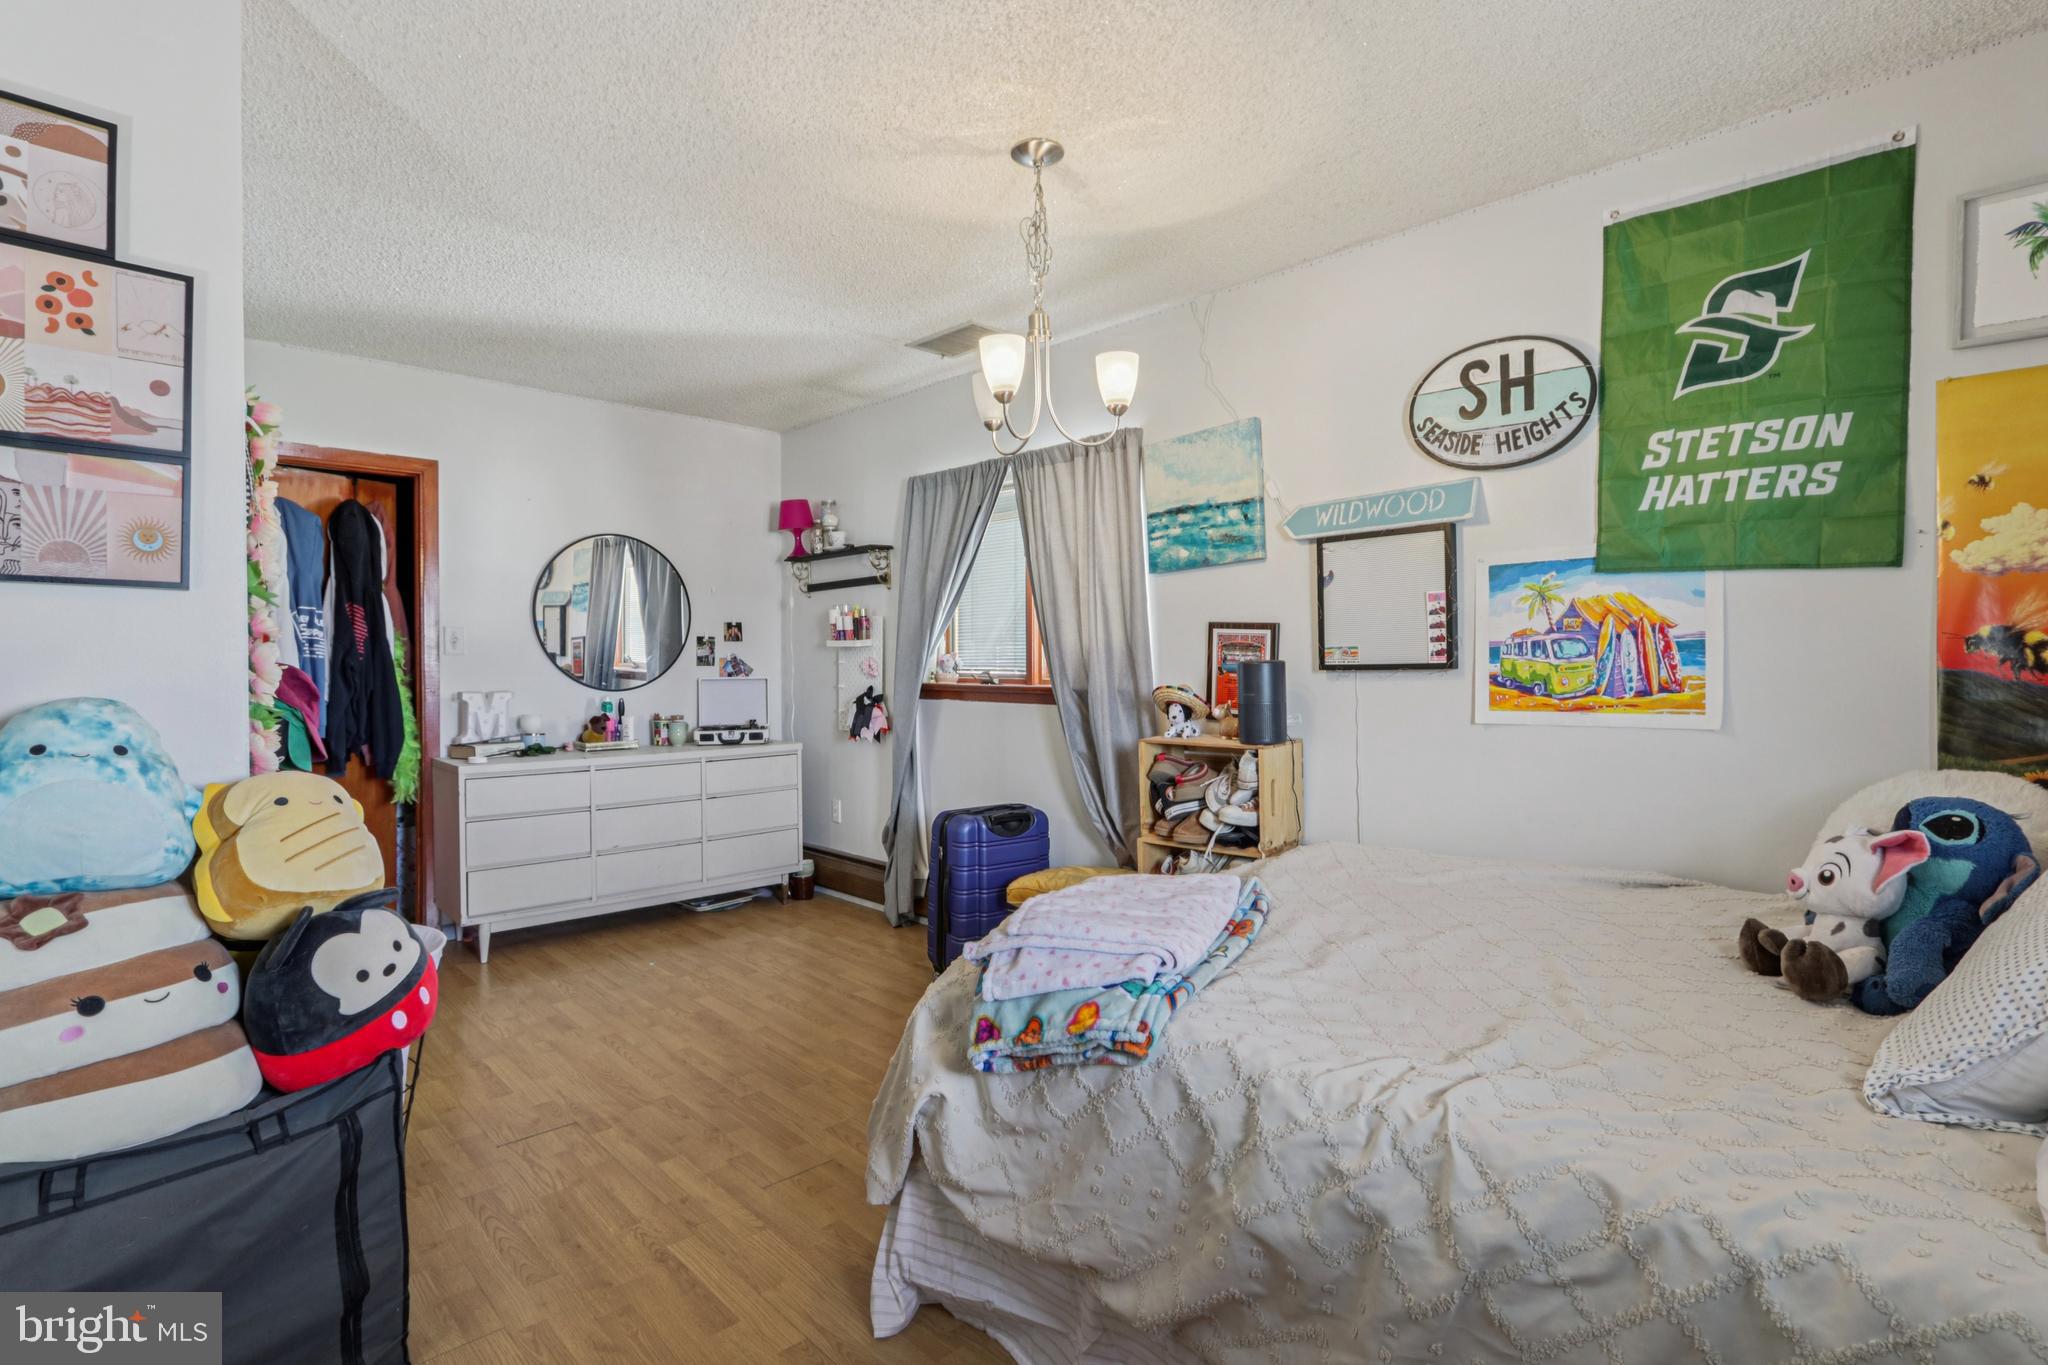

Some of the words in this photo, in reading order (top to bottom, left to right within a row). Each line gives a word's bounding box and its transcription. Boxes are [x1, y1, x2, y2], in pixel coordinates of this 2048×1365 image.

[1458, 348, 1535, 421] SH
[1417, 416, 1483, 456] SEASIDE
[1495, 391, 1588, 454] HEIGHTS
[1641, 411, 1854, 470] STETSON
[1315, 488, 1446, 527] WILDWOOD
[1638, 460, 1843, 511] HATTERS
